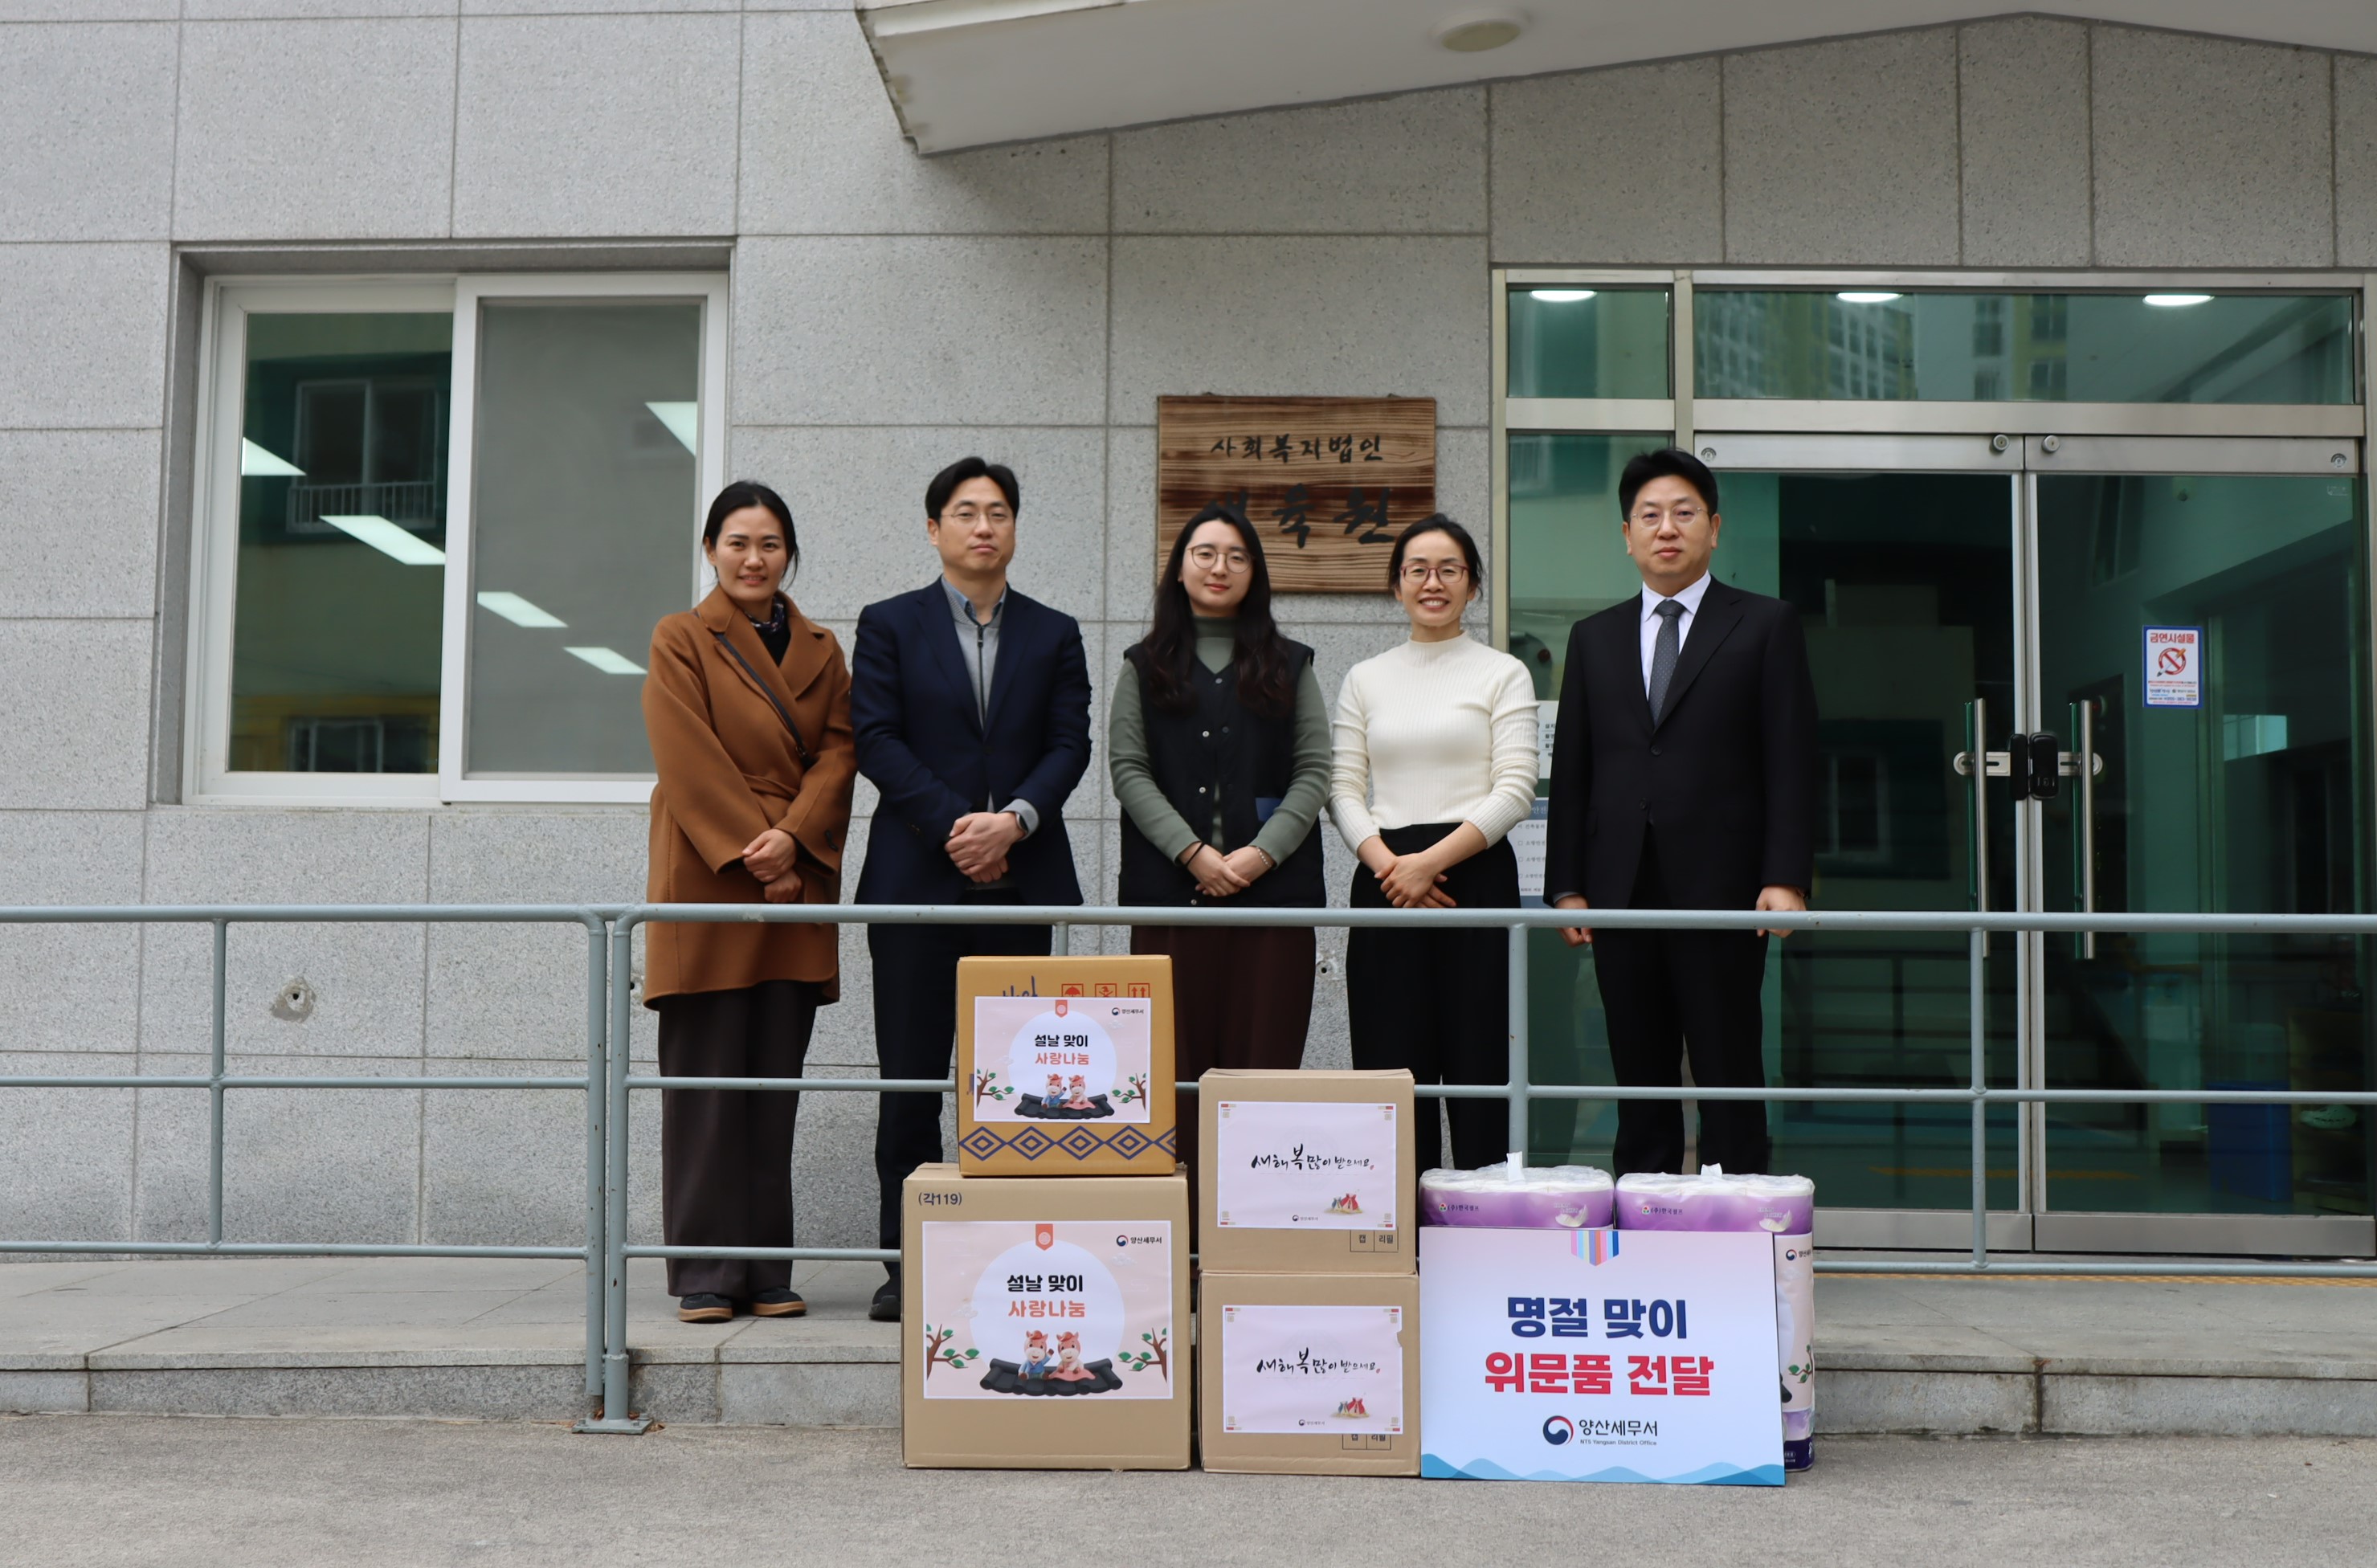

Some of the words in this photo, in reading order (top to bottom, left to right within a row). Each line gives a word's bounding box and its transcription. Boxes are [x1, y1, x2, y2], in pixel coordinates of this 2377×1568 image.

[1210, 433, 1383, 463] 사회복지법인
[2150, 632, 2195, 643] 금연시설물
[1034, 1035, 1060, 1047] 설날
[1064, 1035, 1088, 1047] 맞이
[1035, 1052, 1089, 1065] 사랑나눔
[1251, 1154, 1289, 1170] 새해
[1291, 1143, 1305, 1170] 복
[1307, 1155, 1331, 1170] 많이
[918, 1192, 962, 1206] (각119)
[1130, 1235, 1162, 1244] 양산세무서
[1007, 1275, 1043, 1292] 설날
[1048, 1275, 1084, 1292] 맞이
[1007, 1300, 1085, 1318] 사랑나눔
[1507, 1296, 1589, 1338] 명절
[1603, 1298, 1688, 1339] 맞이
[1256, 1358, 1294, 1374] 새해
[1297, 1347, 1309, 1374] 복
[1313, 1358, 1337, 1374] 많이
[1485, 1351, 1613, 1394] 위문품
[1627, 1354, 1714, 1396] 전달
[1579, 1419, 1658, 1436] 양산세무서
